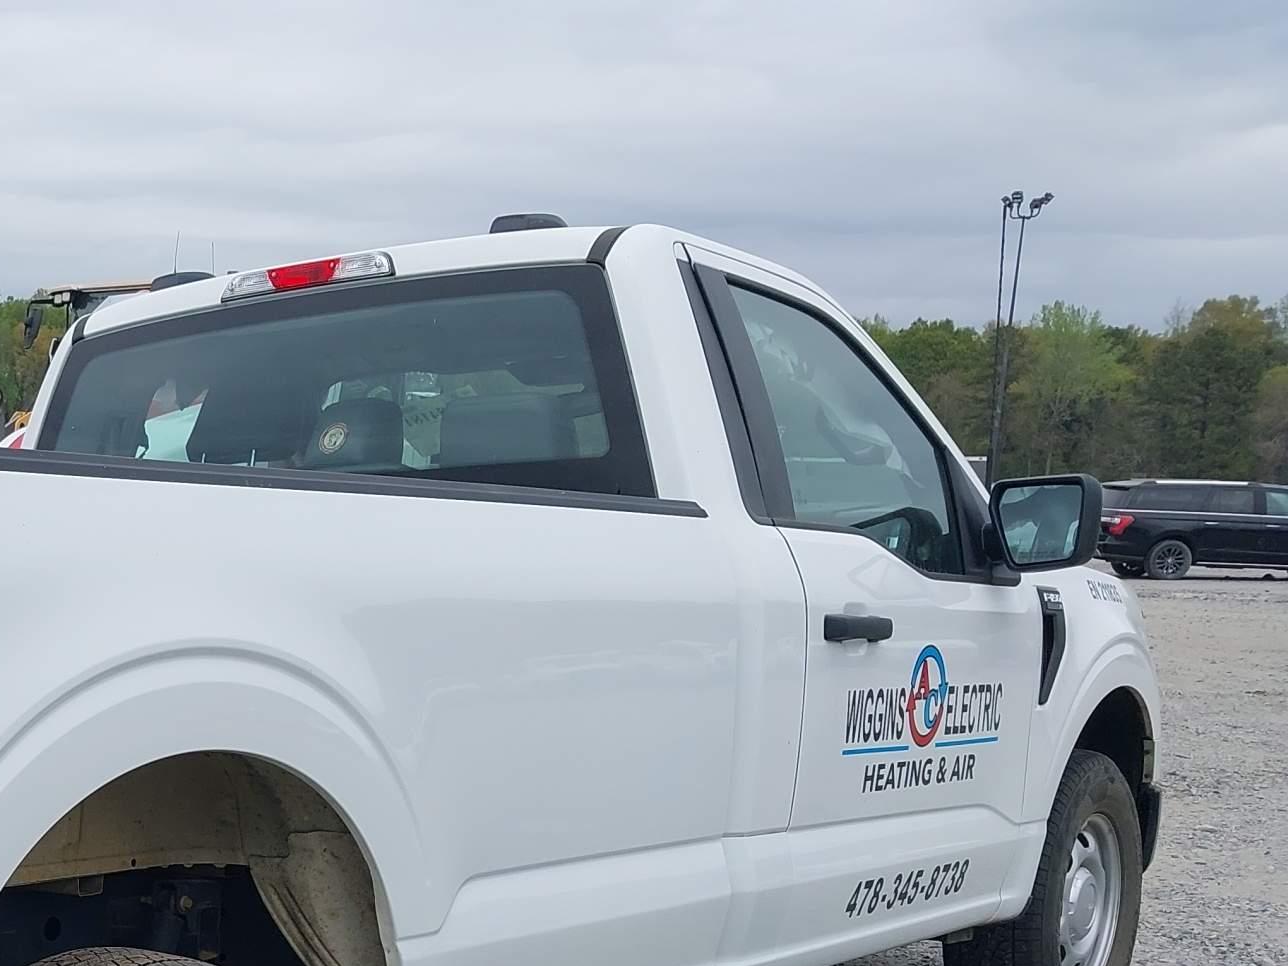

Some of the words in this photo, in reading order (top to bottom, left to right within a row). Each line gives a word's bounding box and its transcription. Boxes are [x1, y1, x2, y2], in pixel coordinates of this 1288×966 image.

[845, 687, 906, 744] WIGGINS
[944, 682, 1003, 735] ELECTRIC
[862, 758, 933, 793] HEATING
[935, 756, 948, 784] &
[949, 754, 976, 782] AIR
[845, 859, 970, 918] 478-345-8738
